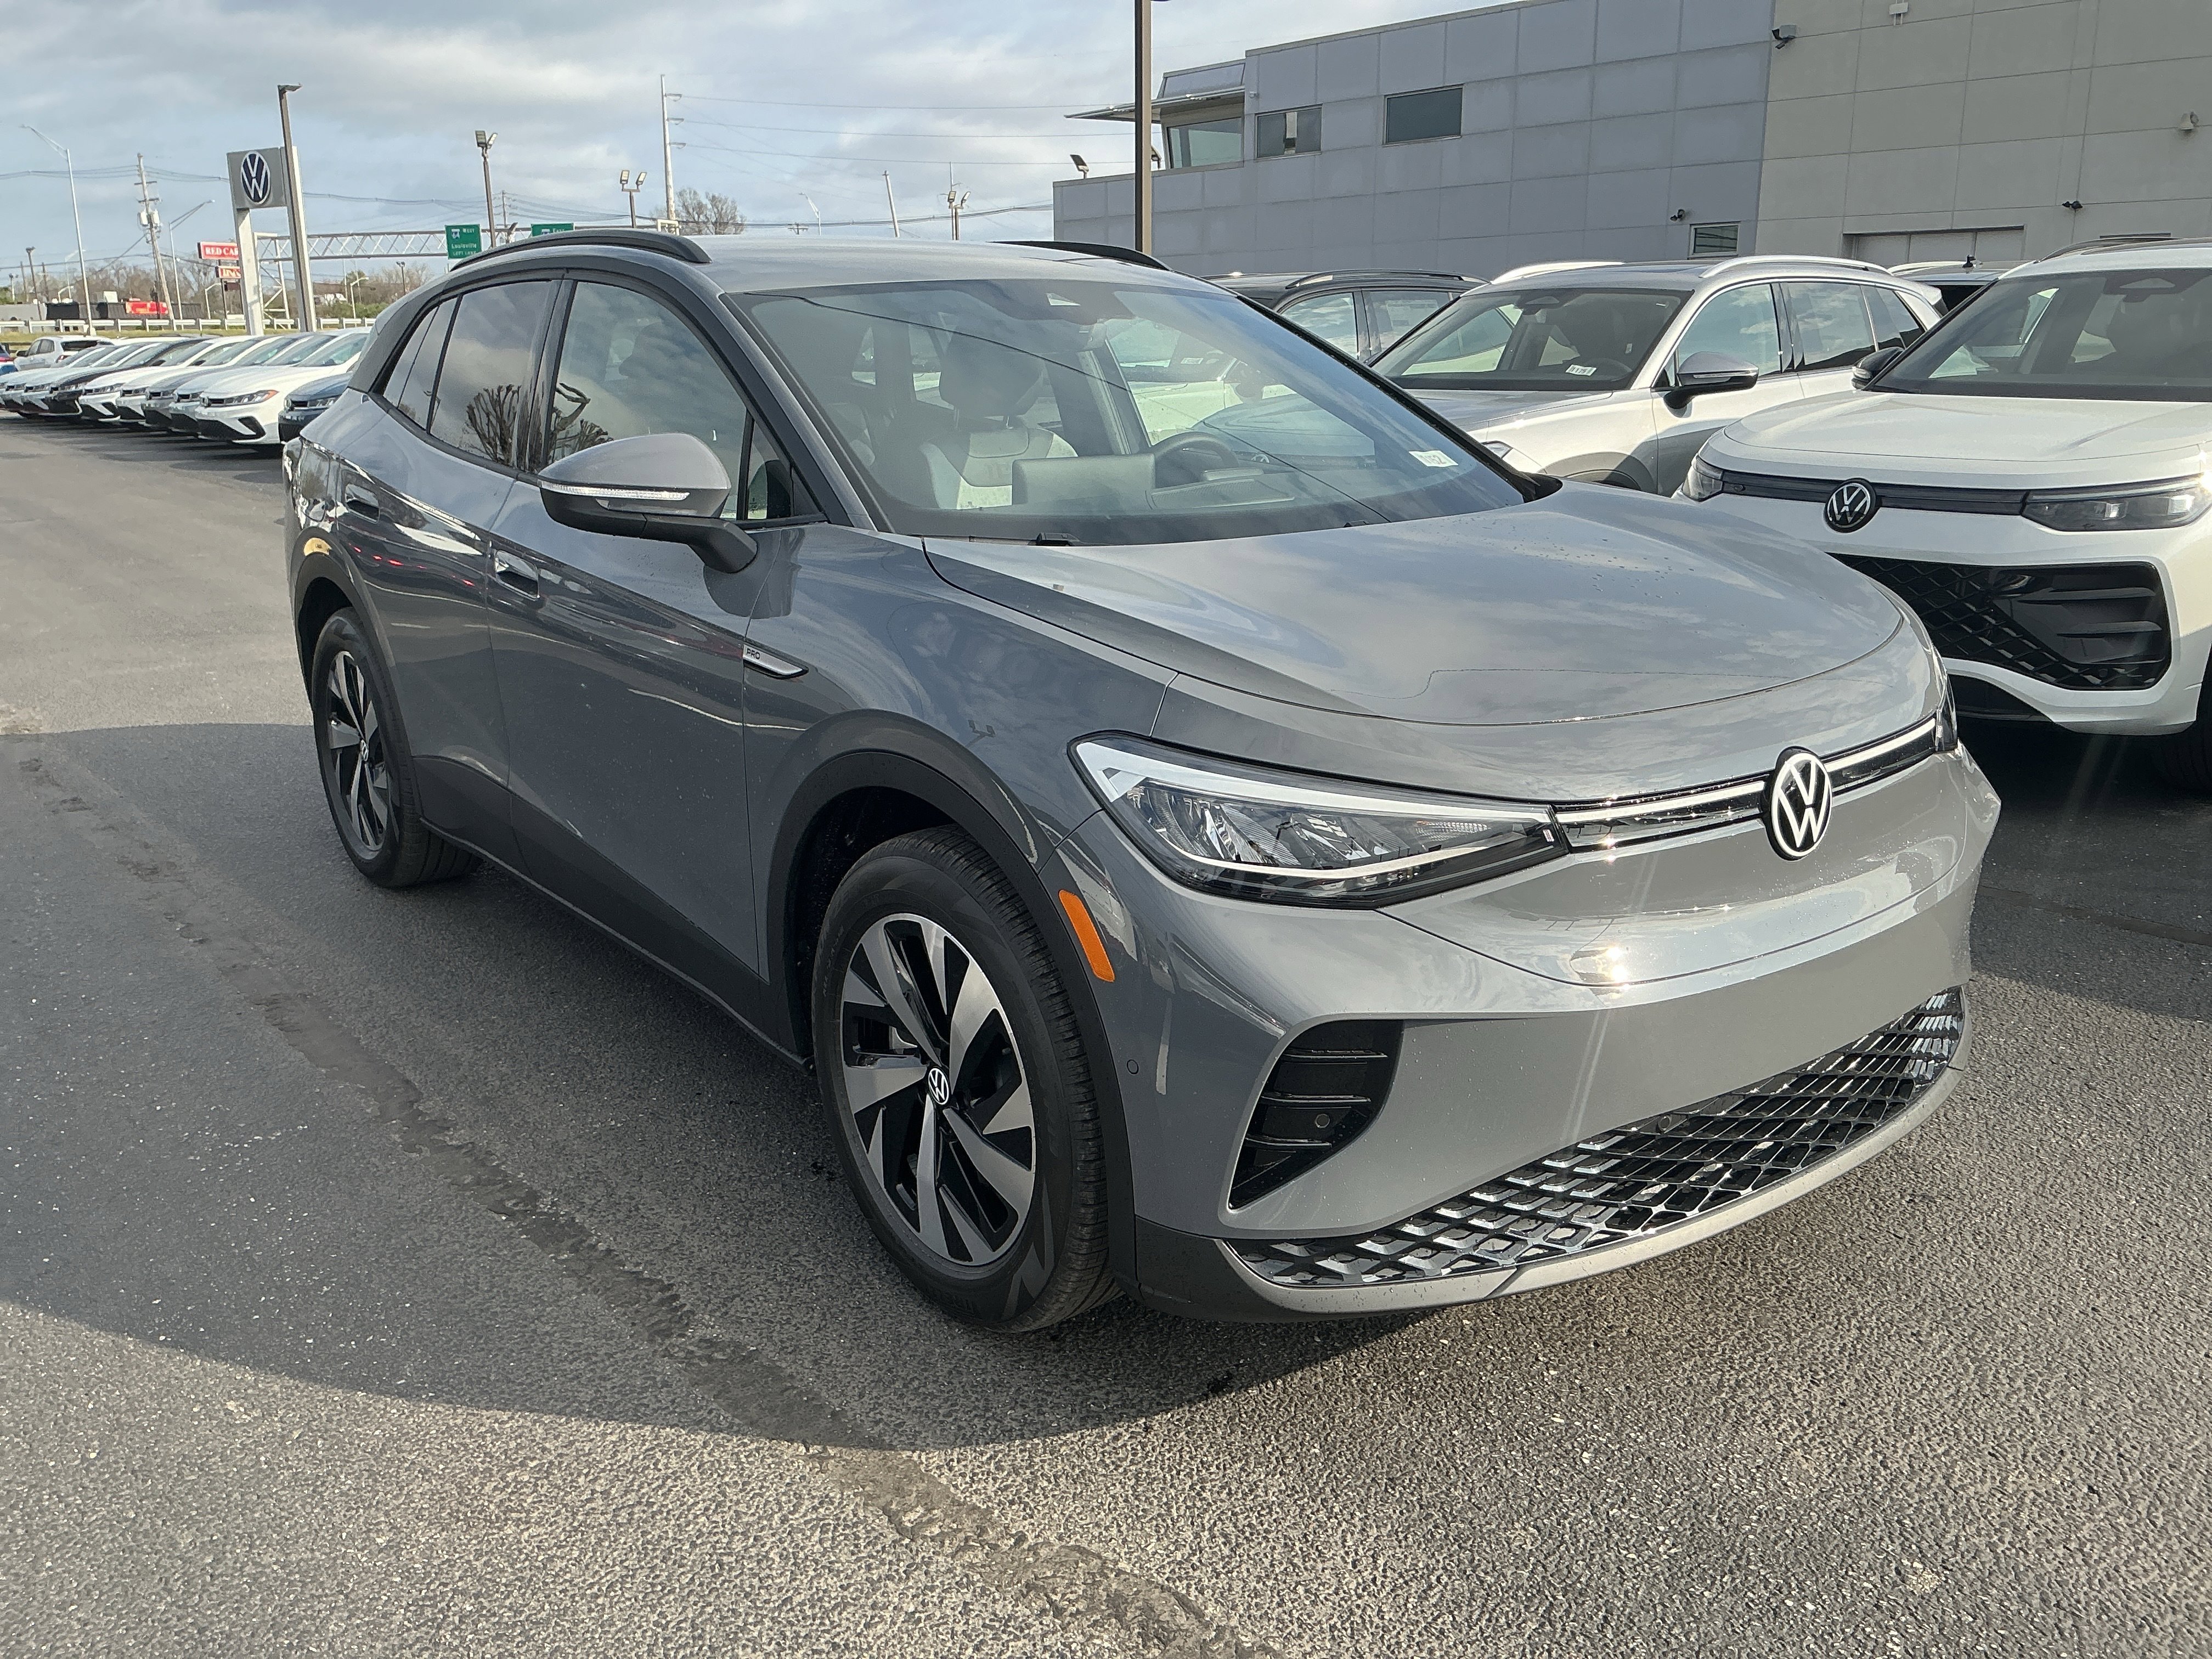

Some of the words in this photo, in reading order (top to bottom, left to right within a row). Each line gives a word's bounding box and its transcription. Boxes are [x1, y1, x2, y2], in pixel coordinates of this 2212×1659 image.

[241, 151, 270, 204] VW
[205, 247, 222, 256] RED
[1827, 483, 1871, 528] VW
[746, 648, 761, 659] PRO
[1771, 753, 1833, 857] VW
[928, 1068, 949, 1105] VW
